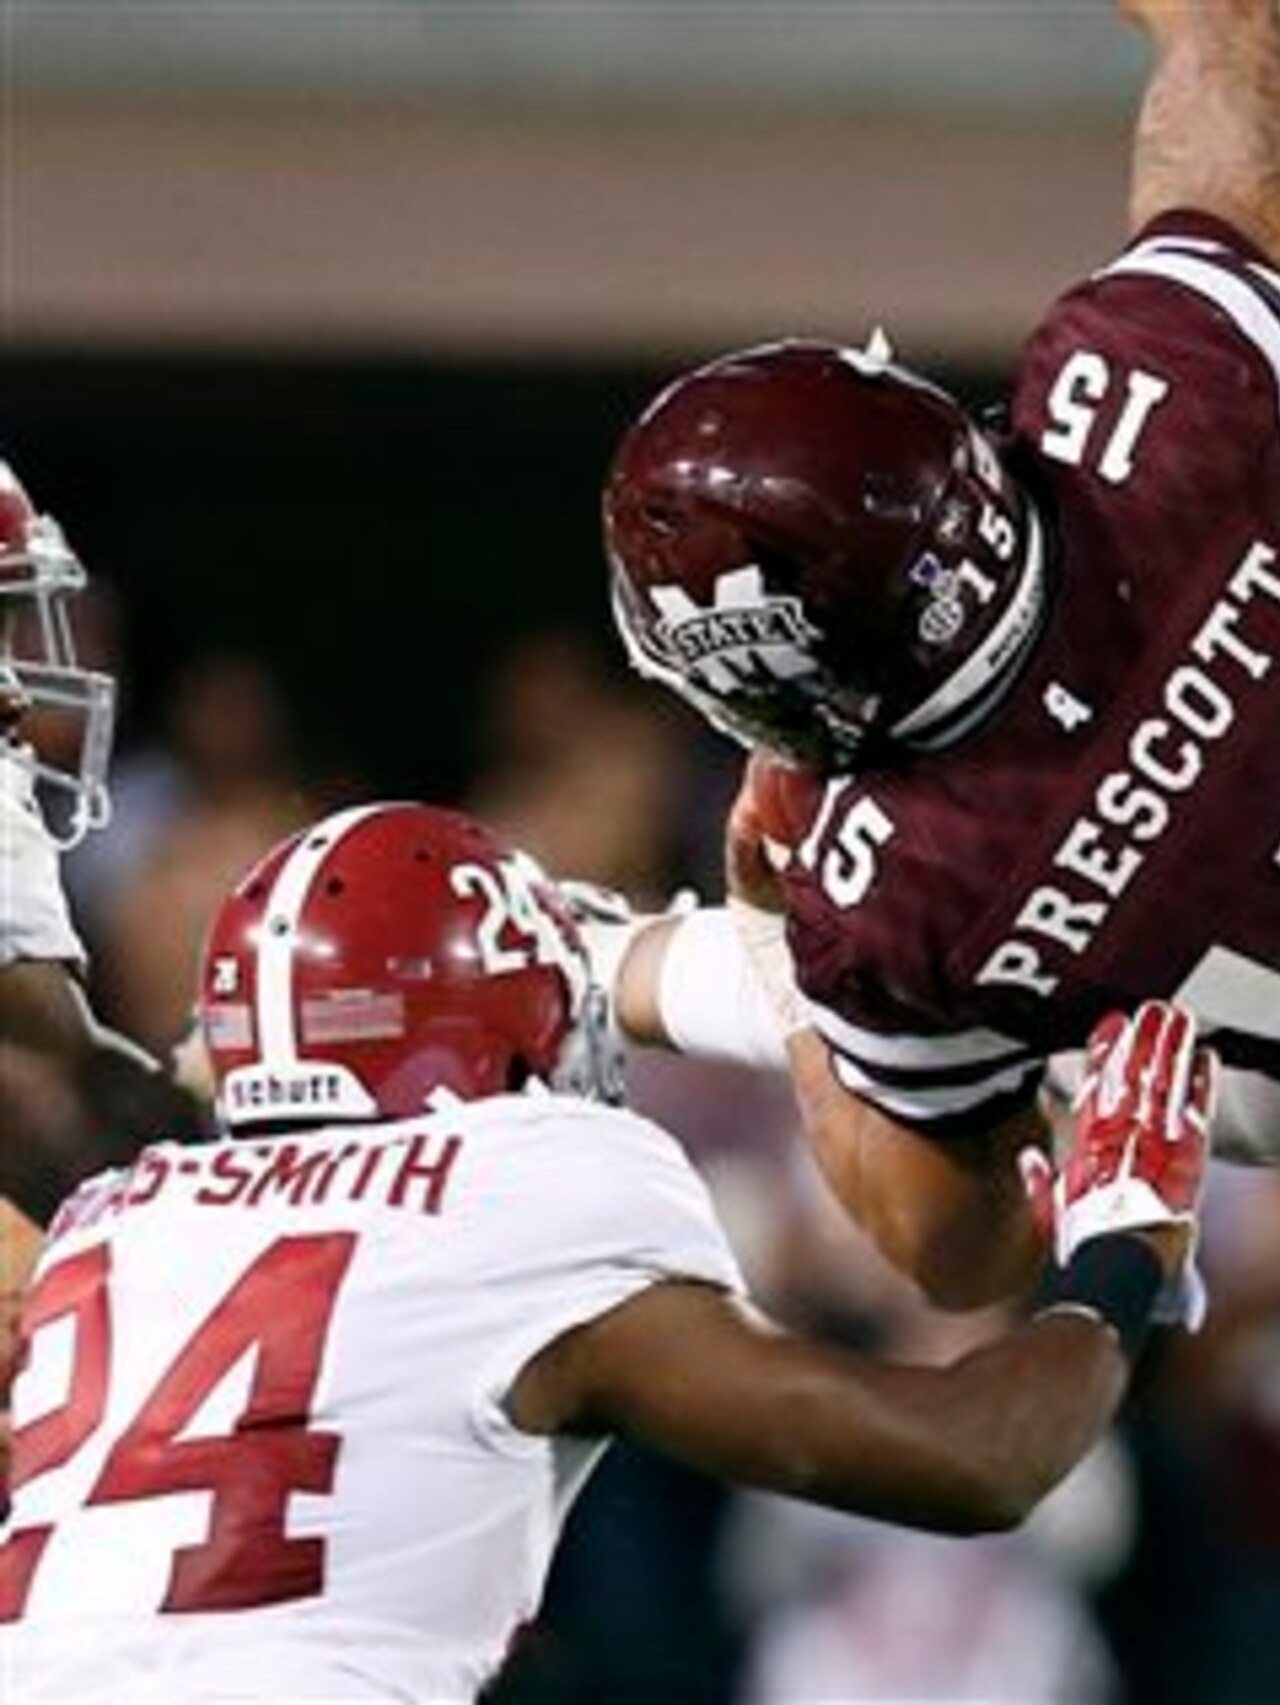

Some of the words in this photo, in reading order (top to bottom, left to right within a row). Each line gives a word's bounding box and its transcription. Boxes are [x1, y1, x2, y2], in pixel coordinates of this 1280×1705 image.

[1042, 350, 1168, 482] 15
[957, 503, 1017, 604] 15
[451, 851, 568, 975] 24
